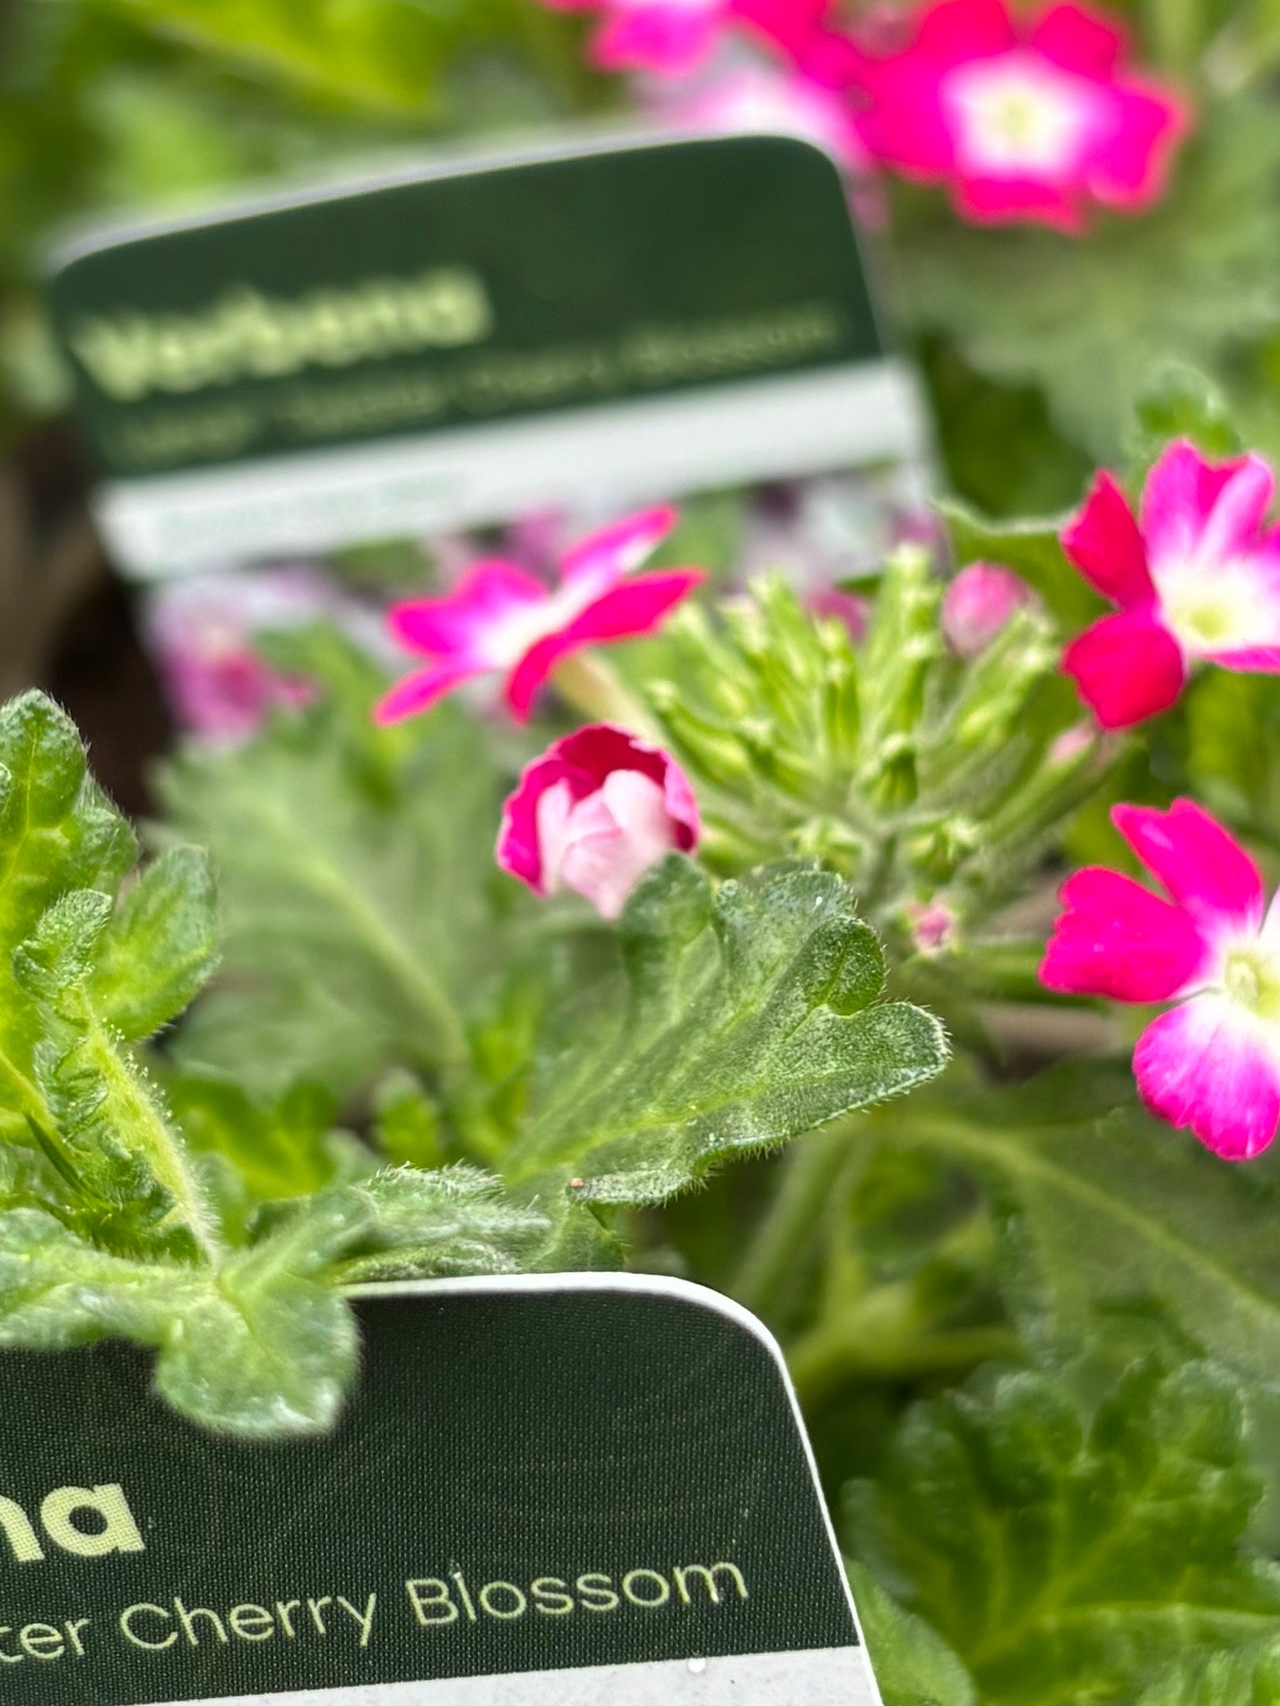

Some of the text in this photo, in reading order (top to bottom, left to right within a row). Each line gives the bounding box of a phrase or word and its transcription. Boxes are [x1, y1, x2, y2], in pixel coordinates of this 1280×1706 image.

[76, 268, 490, 398] Verbena
[119, 1593, 377, 1650] Cherry
[405, 1559, 750, 1627] Blossom
